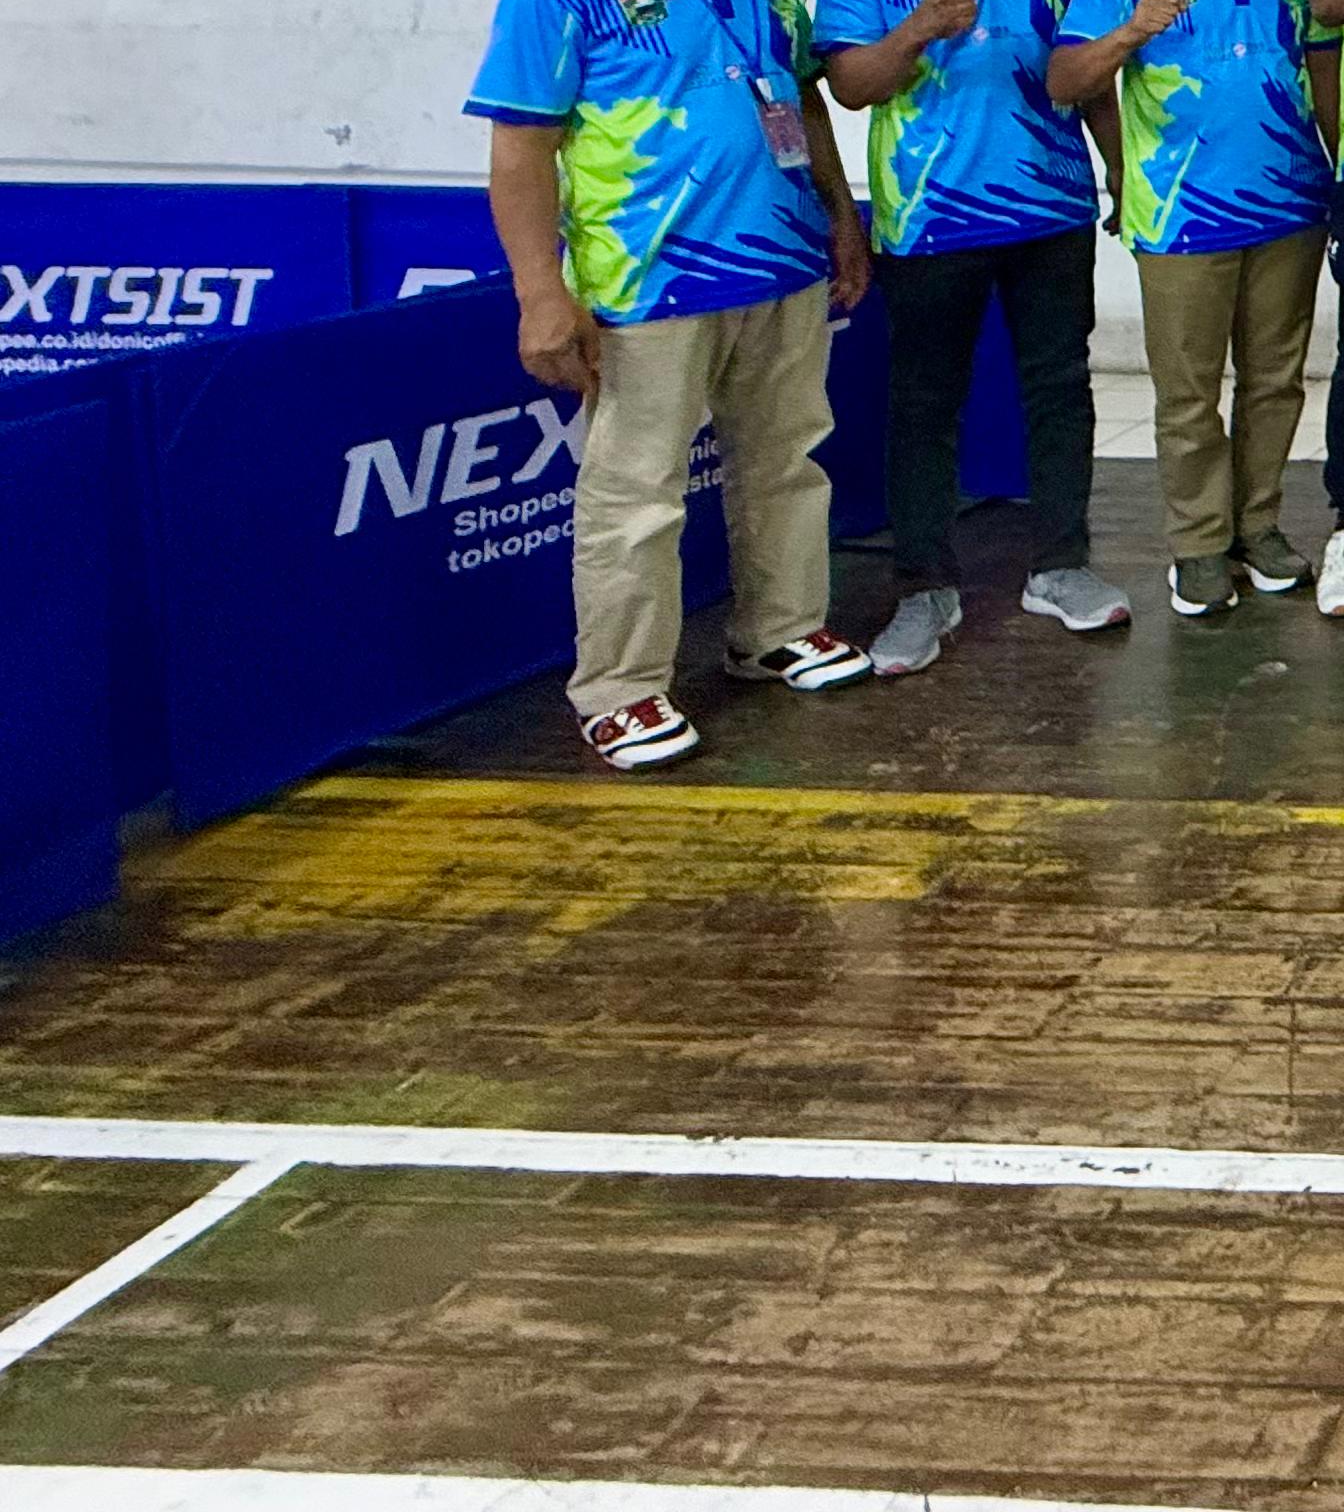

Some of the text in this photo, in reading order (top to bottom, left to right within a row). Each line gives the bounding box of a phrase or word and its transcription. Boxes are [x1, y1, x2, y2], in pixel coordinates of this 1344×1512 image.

[0, 265, 274, 326] XTSIST
[335, 397, 588, 537] NEX
[453, 487, 576, 538] Shopee
